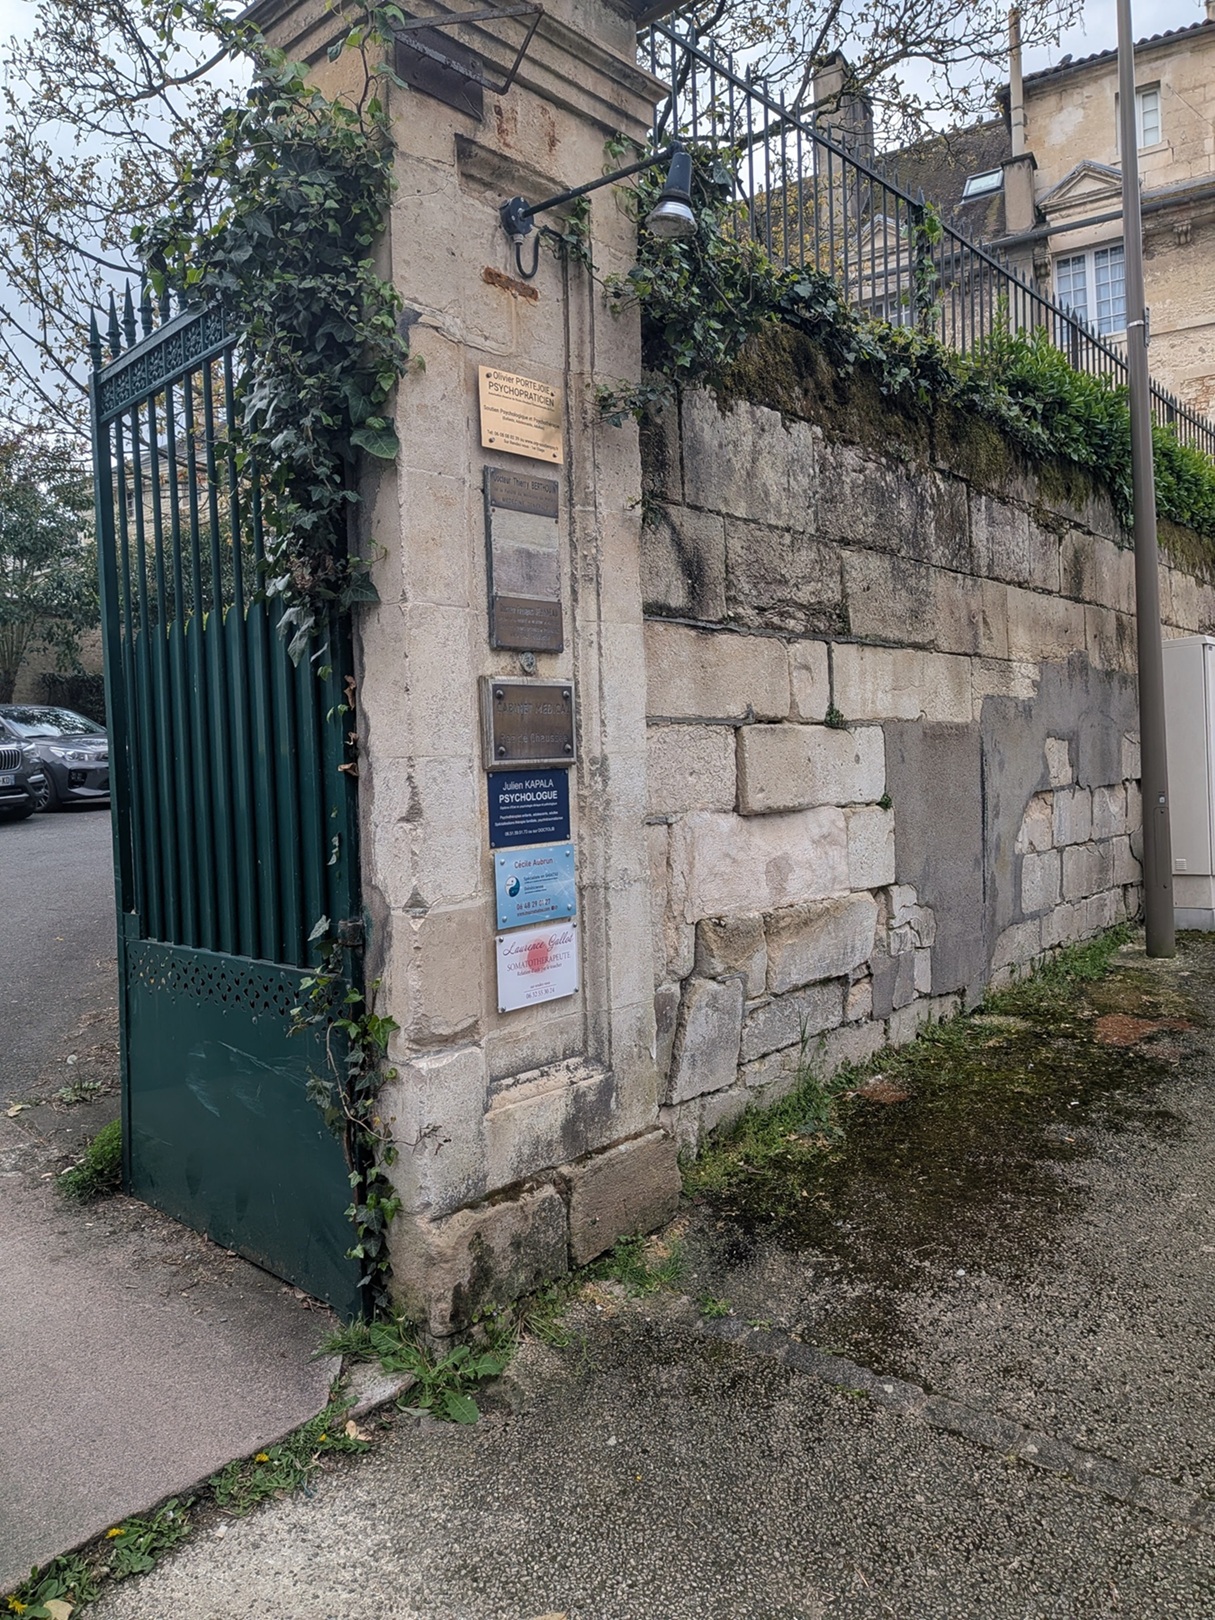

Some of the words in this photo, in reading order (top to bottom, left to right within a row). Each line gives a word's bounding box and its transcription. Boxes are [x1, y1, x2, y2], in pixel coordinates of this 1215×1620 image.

[493, 371, 514, 383] Olivier
[516, 377, 550, 394] PORTEJOIE
[489, 382, 554, 407] PSYCHOPRATICIEN
[503, 782, 523, 790] Julien
[525, 779, 554, 789] KAPALA
[499, 791, 558, 803] PSYCHOLOGUE
[503, 942, 544, 956] Laurence
[507, 951, 570, 971] SOMATOTHERAPEUTE
